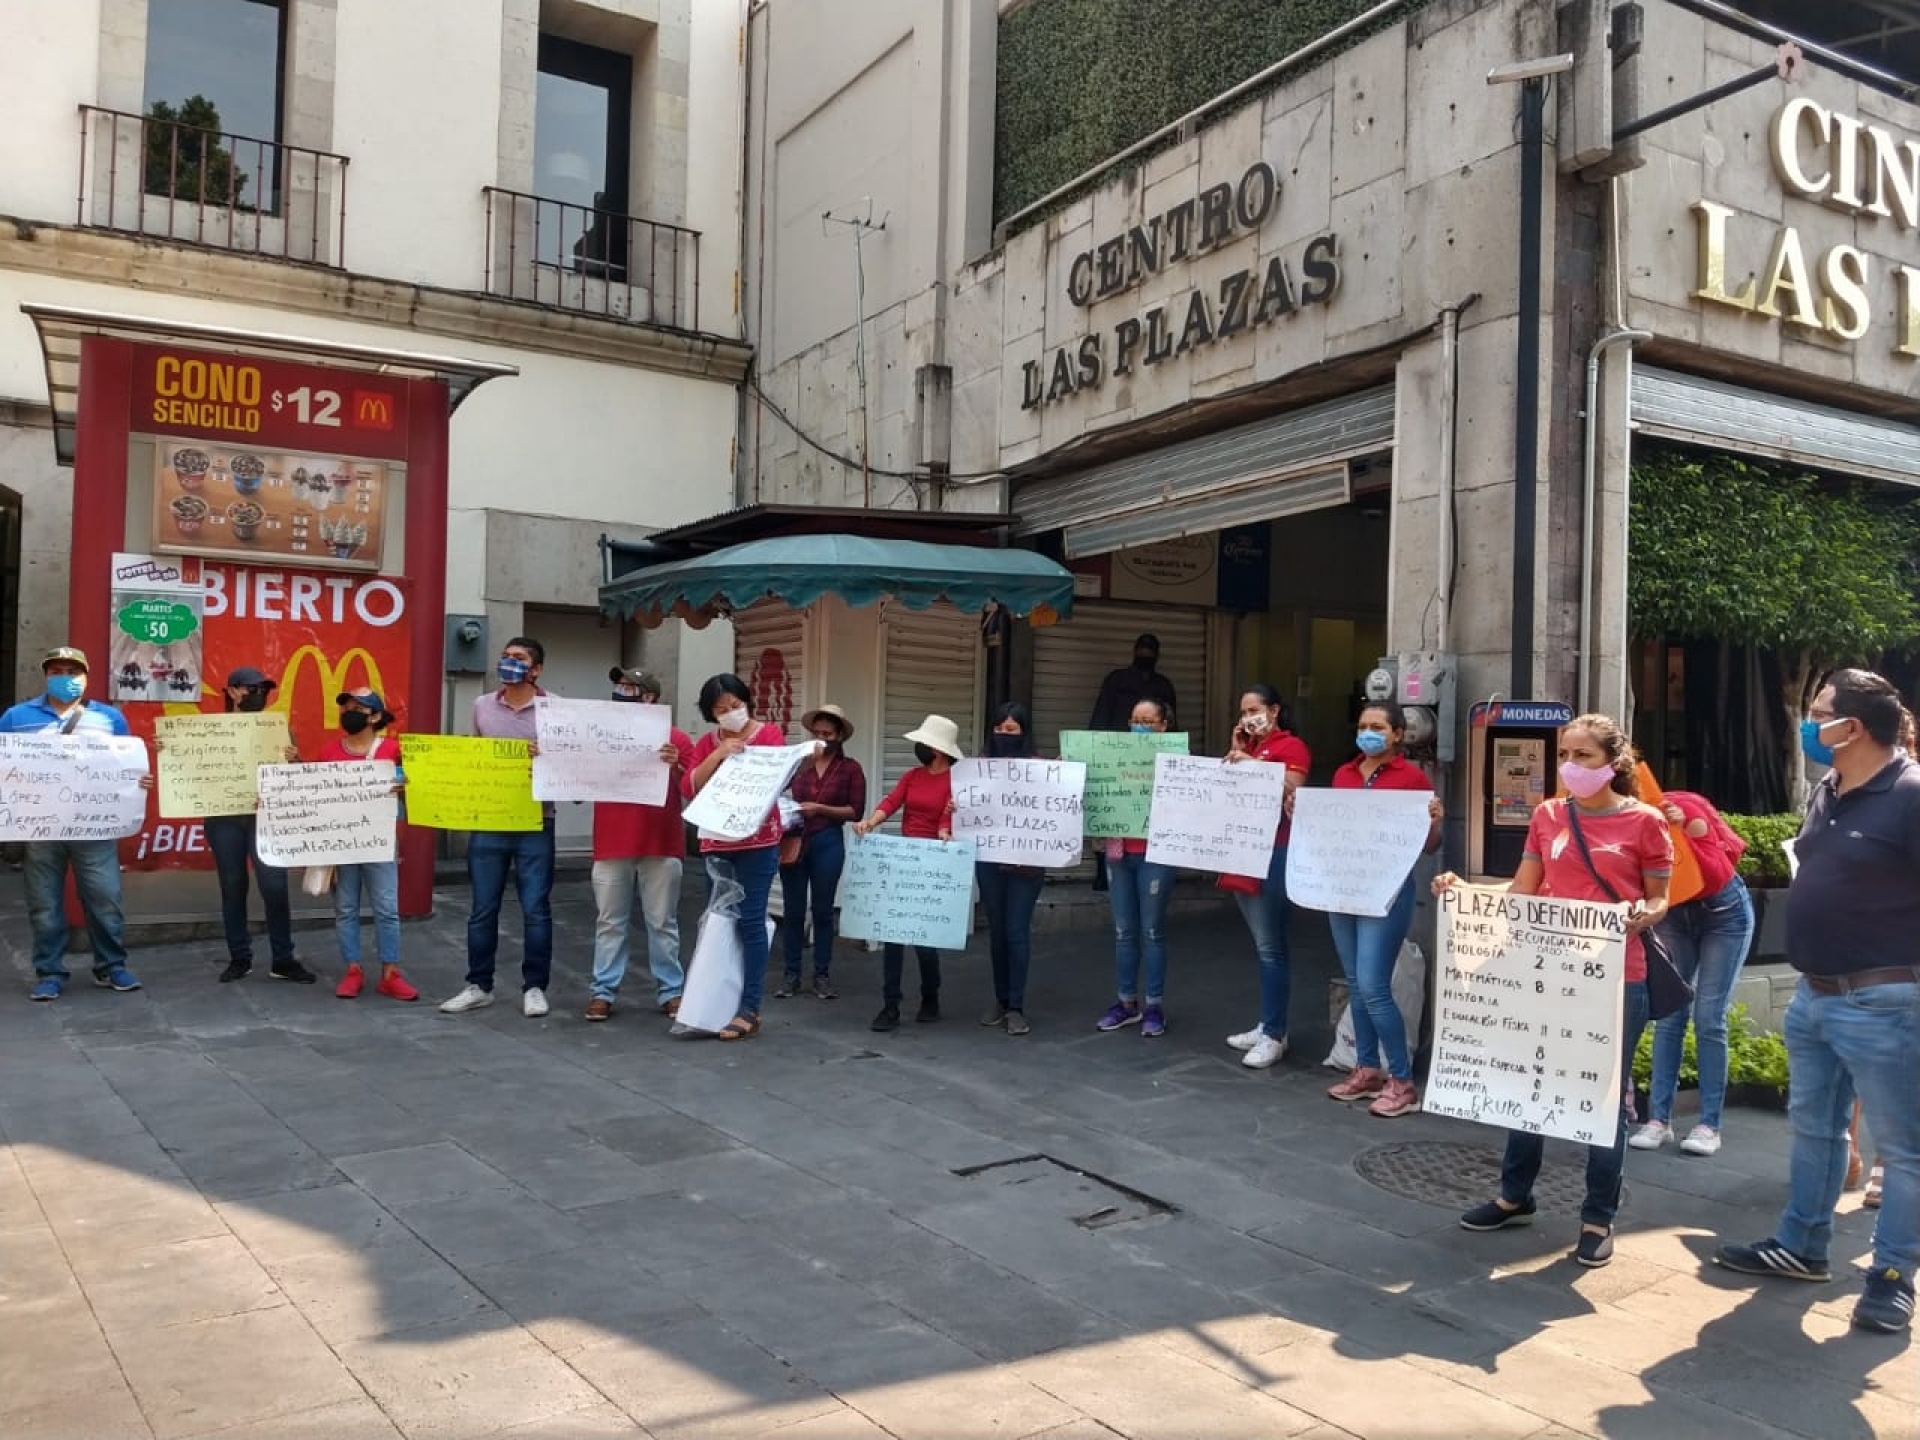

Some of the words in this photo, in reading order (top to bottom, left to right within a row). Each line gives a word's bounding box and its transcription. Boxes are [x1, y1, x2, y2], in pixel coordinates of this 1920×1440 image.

[1068, 161, 1276, 308] CENTRO
[1690, 200, 1870, 340] LAS
[1021, 333, 1101, 411] LAS
[1112, 233, 1338, 377] PLAZAS
[155, 356, 262, 406] CONO
[270, 386, 343, 427] $12
[153, 398, 260, 433] SENCILLO
[1502, 707, 1571, 721] MONEDAS
[59, 785, 121, 804] OBRADOR
[961, 815, 994, 828] LAS
[1006, 815, 1058, 832] PLAZAS
[1443, 889, 1521, 921] PLAZAS
[1528, 900, 1627, 934] DEFINITIVAS
[1456, 920, 1500, 936] NIVEL
[1508, 927, 1592, 951] SECUNDARIA
[1445, 966, 1522, 990] MATEMÁTICAS
[1534, 955, 1545, 970] 2
[1583, 962, 1606, 980] 85
[1443, 989, 1500, 1007] HISTORIA
[1472, 1095, 1524, 1118] GRUPO
